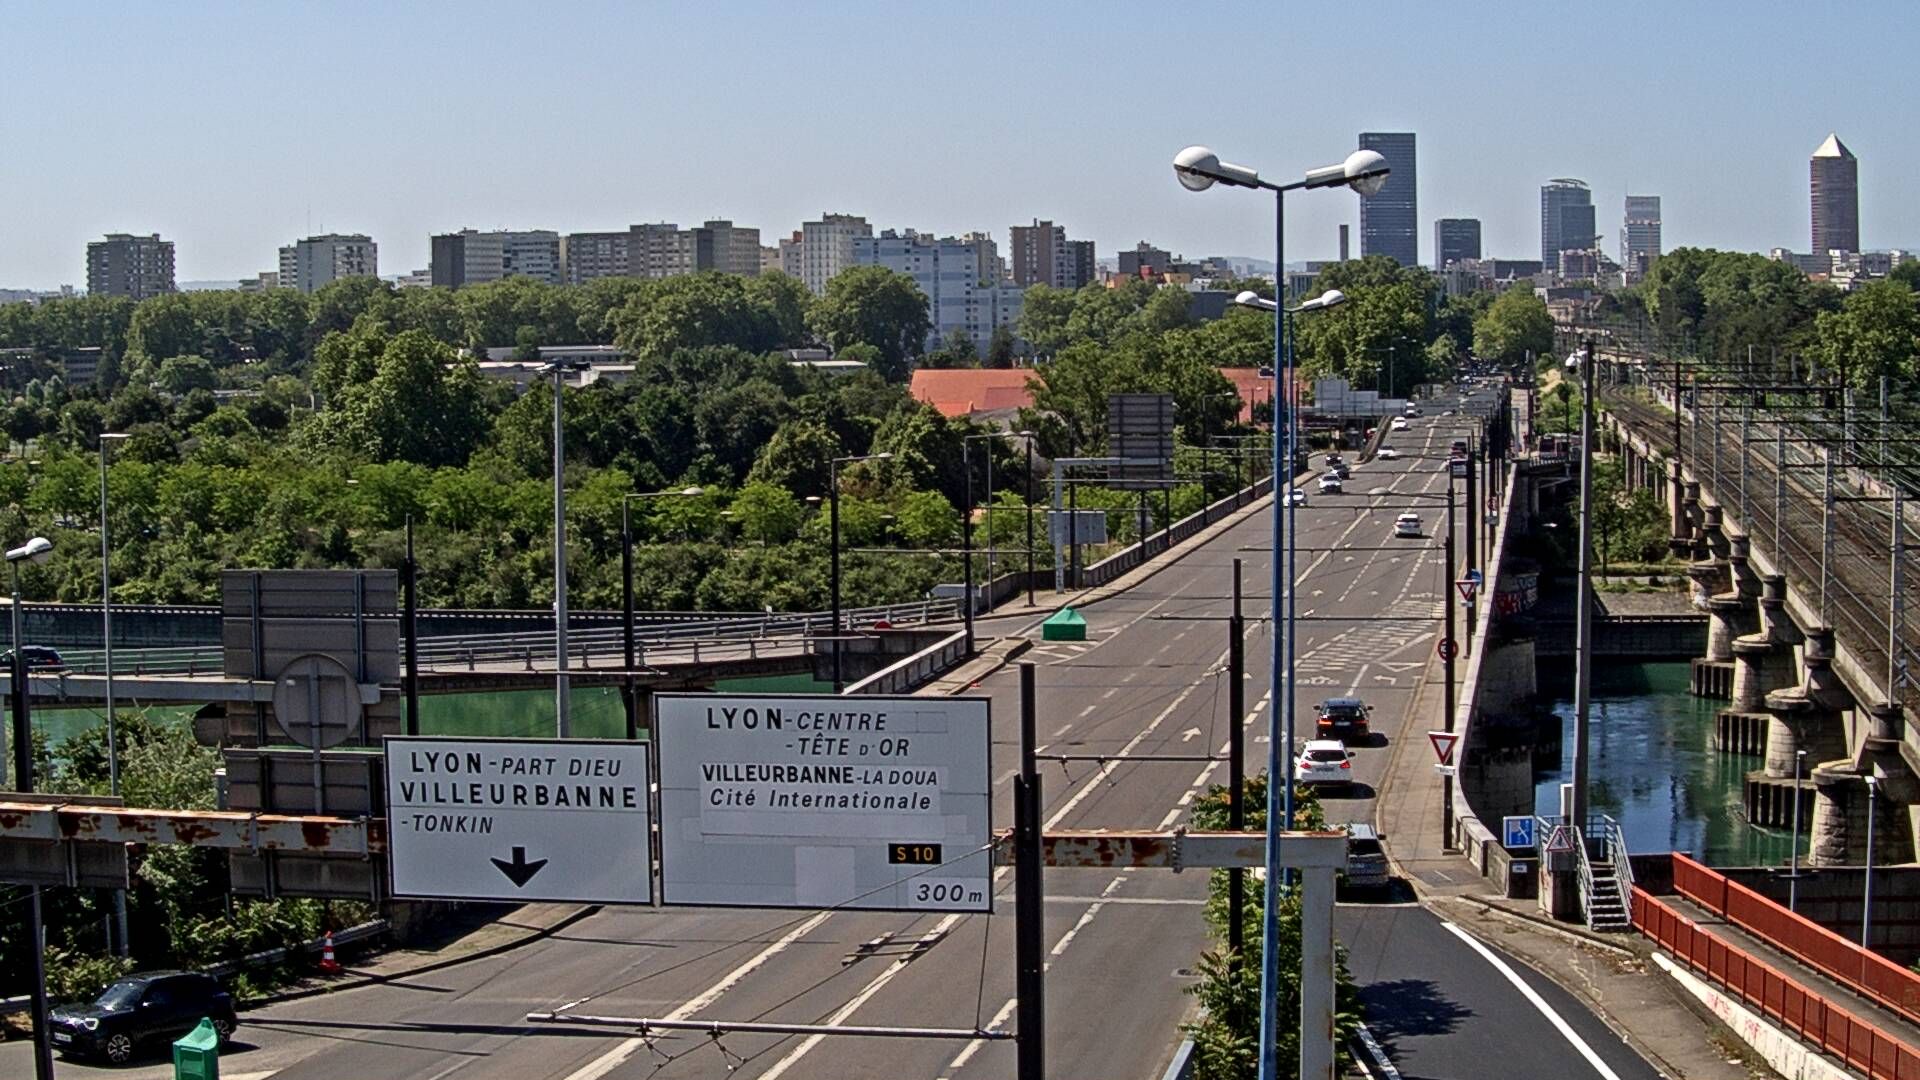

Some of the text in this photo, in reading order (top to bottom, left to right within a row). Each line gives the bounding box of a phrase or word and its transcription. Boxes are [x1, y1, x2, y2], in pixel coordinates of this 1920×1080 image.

[568, 758, 621, 777] DIEU
[888, 770, 937, 786] DOUA
[400, 782, 637, 808] VILLEURBANNE
[710, 788, 931, 810] Cité Internationale
